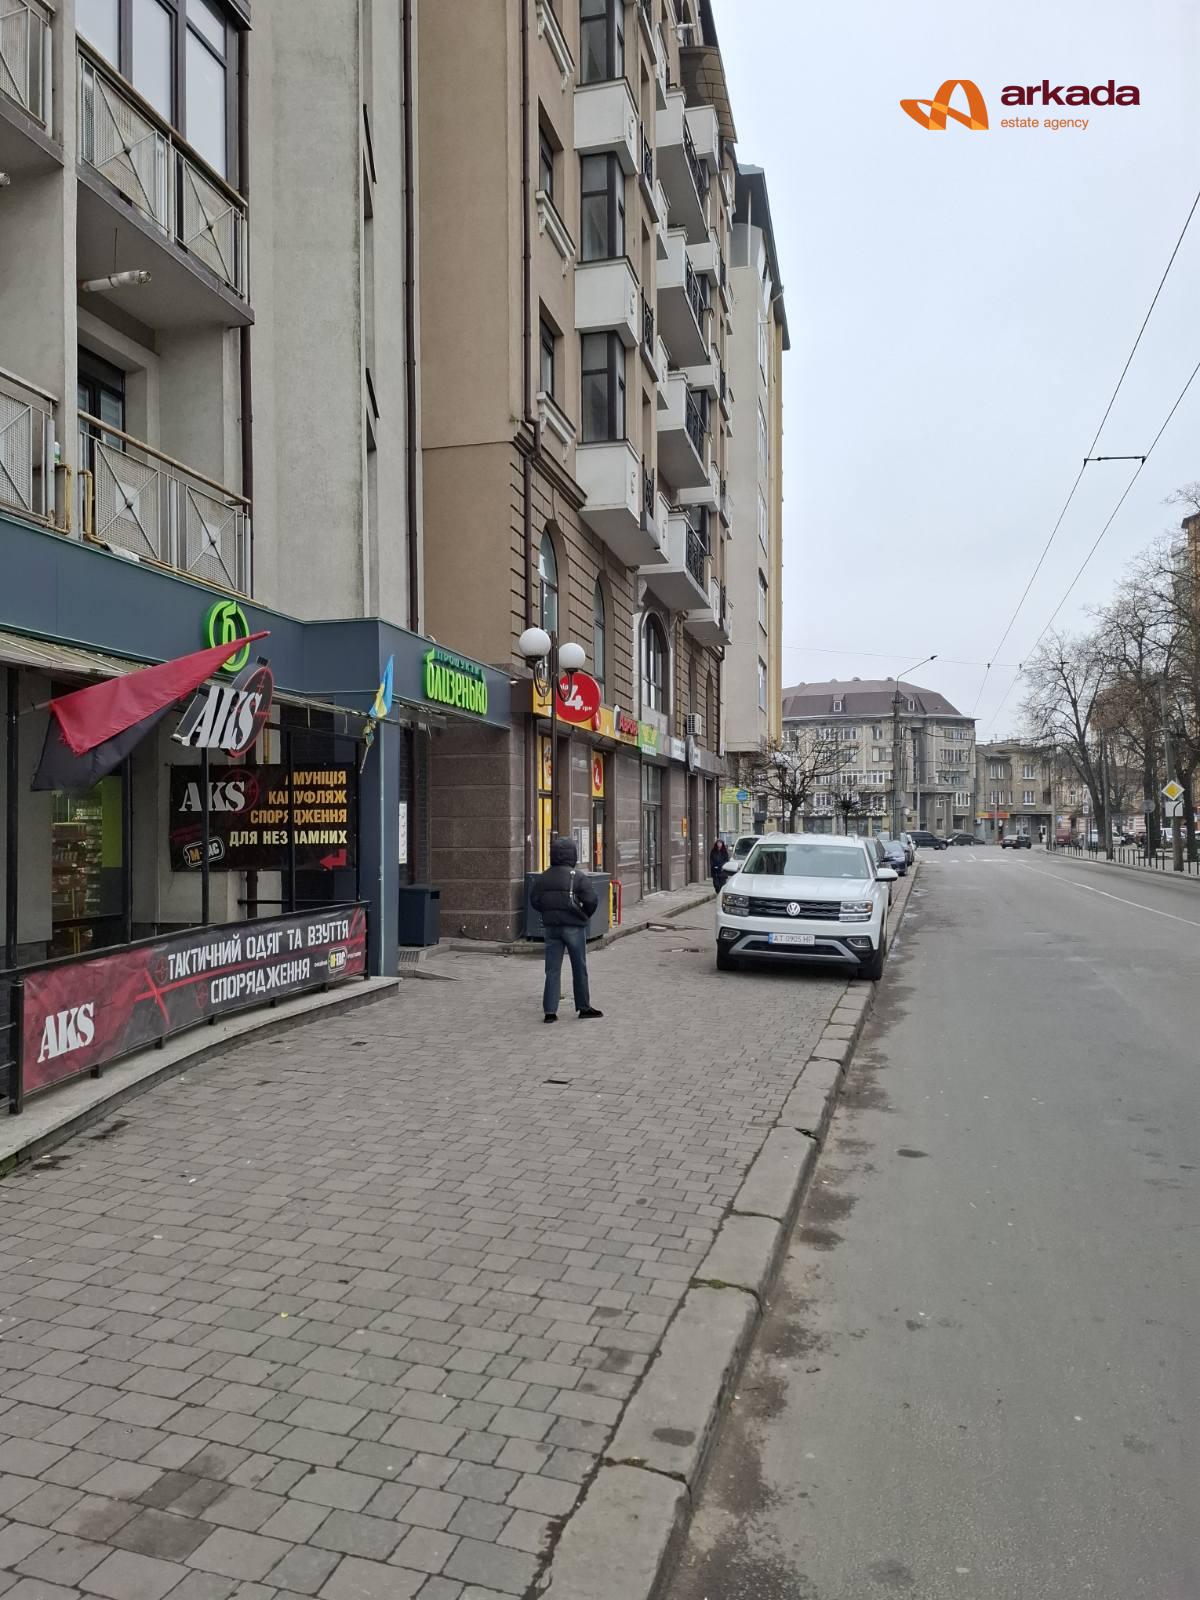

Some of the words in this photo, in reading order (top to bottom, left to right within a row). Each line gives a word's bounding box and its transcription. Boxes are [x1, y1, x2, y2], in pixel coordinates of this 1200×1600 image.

[565, 685, 584, 710] 4
[174, 685, 263, 751] AKS
[284, 771, 347, 787] МУНІЦІЯ
[178, 781, 246, 812] AKS
[189, 842, 220, 862] M-AC
[229, 831, 258, 847] ДЛЯ
[168, 933, 242, 981] ТАКТИЧНИЙ
[246, 932, 283, 961] ОДЯГ
[287, 928, 302, 951] ТА
[307, 919, 349, 947] ВЗУТТЯ
[210, 957, 310, 1004] СПОРЯДЖЕННЯ
[37, 1002, 95, 1063] AKS
